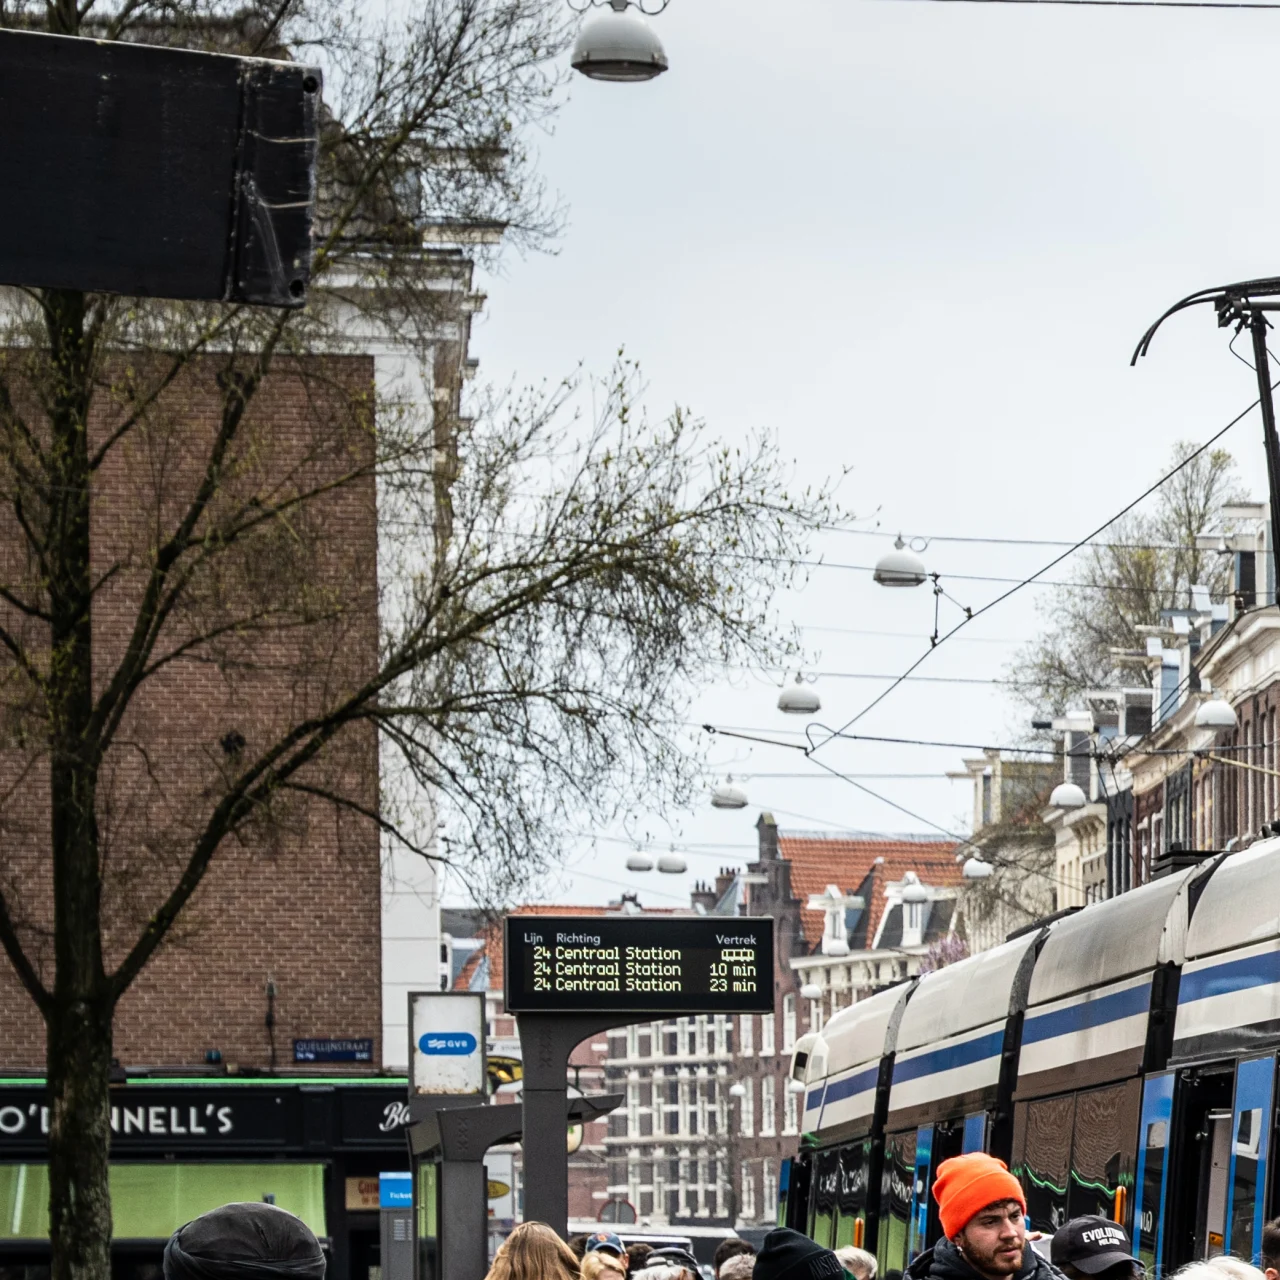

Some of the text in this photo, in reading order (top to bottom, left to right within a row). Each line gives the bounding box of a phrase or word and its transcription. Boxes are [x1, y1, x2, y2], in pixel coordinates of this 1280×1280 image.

[524, 932, 757, 946] Lijn Richting Vertrek
[533, 946, 681, 961] 24 Centraal Station
[533, 963, 757, 977] 24 Centraal Station 10 min
[533, 978, 757, 992] 24 Centraal Station 23 min
